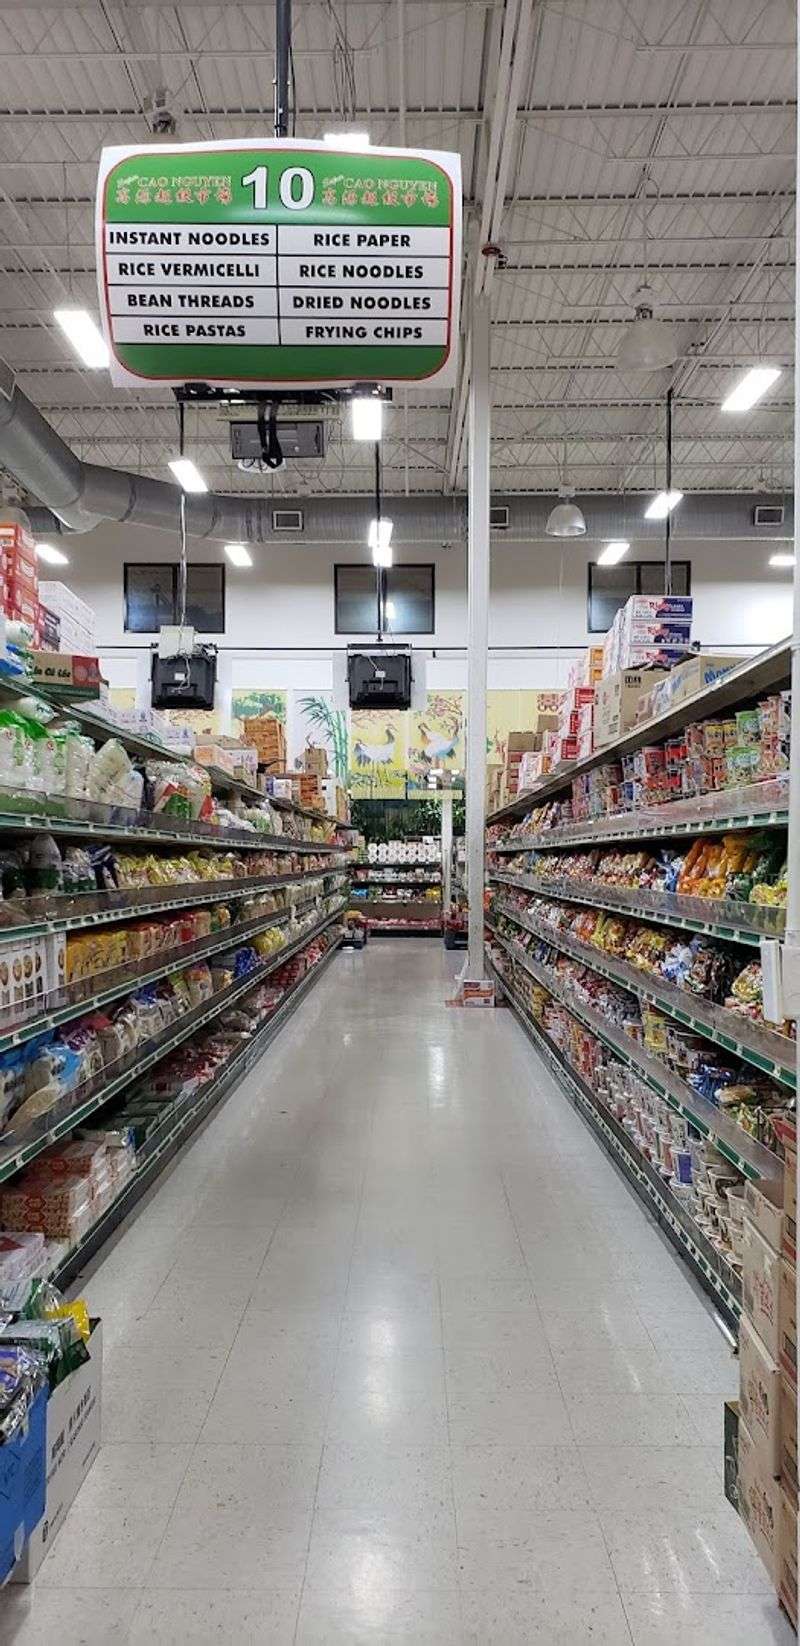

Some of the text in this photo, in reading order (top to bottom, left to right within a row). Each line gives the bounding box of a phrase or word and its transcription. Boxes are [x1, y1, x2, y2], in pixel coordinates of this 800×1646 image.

[138, 176, 168, 188] CAO
[241, 165, 316, 210] 10
[343, 178, 374, 190] CAO
[109, 231, 270, 246] INSTANT NOODLES
[313, 233, 411, 247] RICE PAPER
[118, 263, 260, 277] RICE VERMICELLI
[299, 265, 424, 279] RICE NOODLES
[127, 294, 255, 308] BEAN THREADS
[292, 296, 432, 310] DRIED NOODLES
[143, 324, 246, 338] RICE PASTAS
[305, 326, 423, 340] FRYING CHIPS
